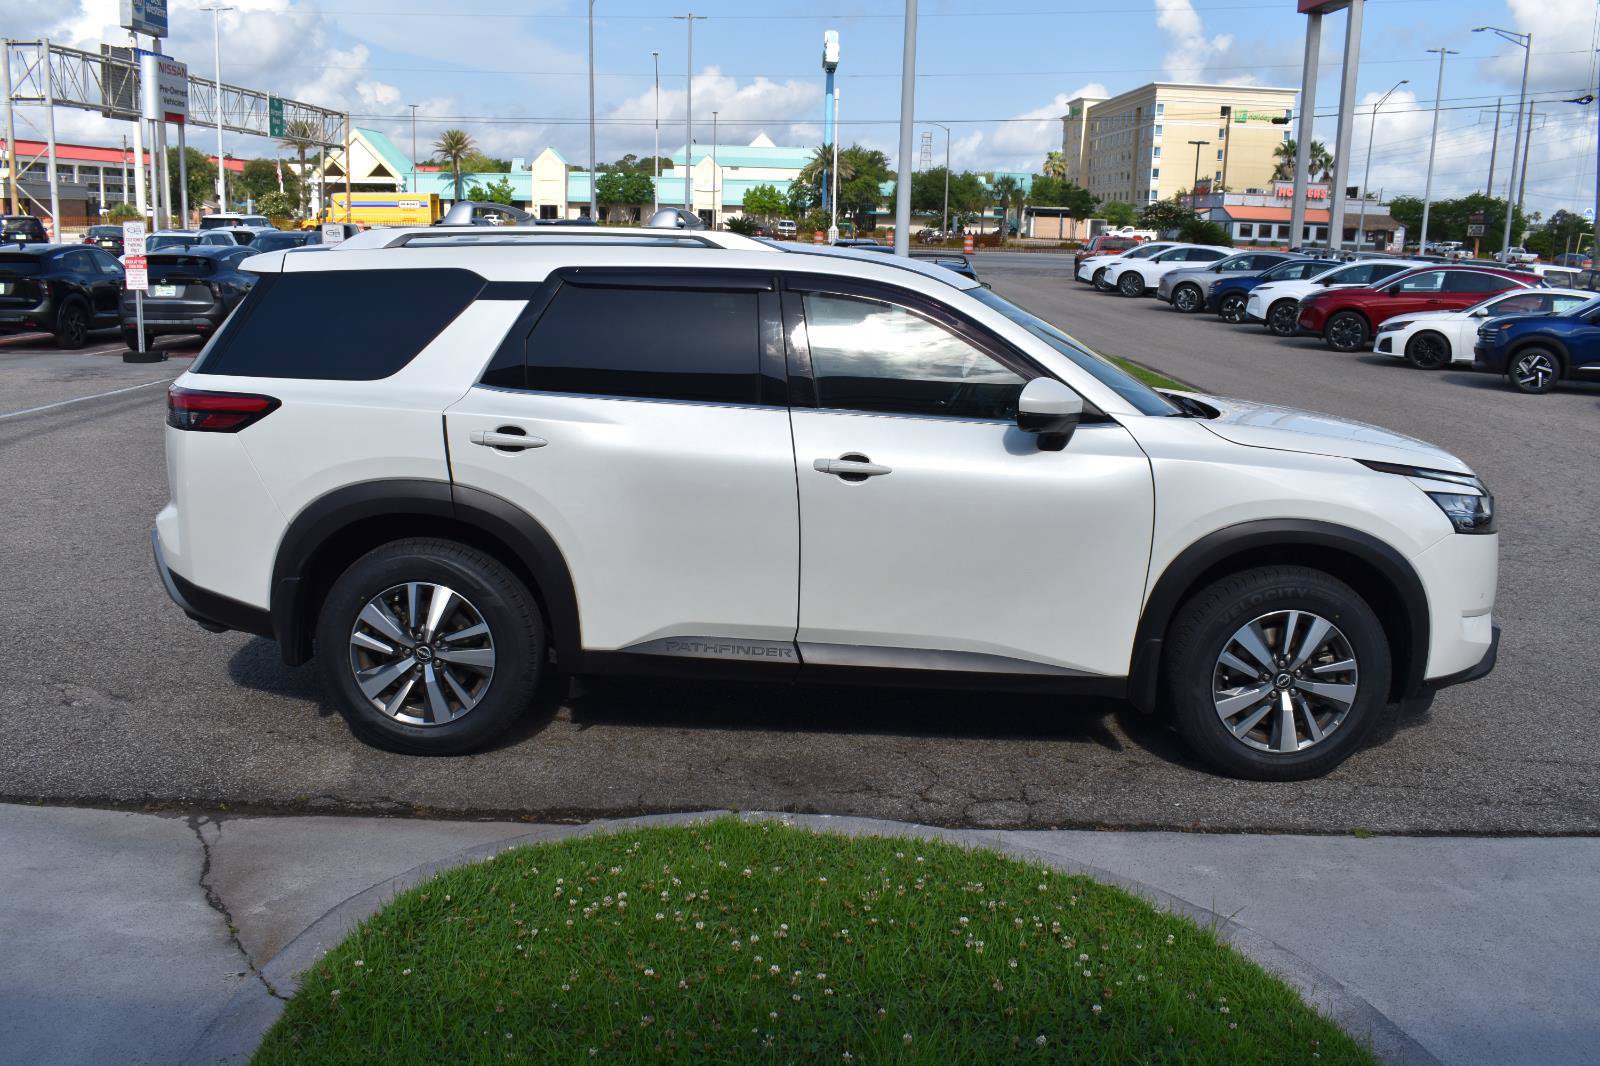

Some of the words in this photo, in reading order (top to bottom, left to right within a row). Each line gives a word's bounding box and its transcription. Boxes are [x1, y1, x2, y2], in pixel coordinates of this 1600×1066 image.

[146, 2, 167, 18] Western
[158, 62, 187, 78] NISSAN
[159, 85, 188, 97] Pre-Owned
[163, 98, 185, 108] Vehicles
[1278, 187, 1328, 199] HOERS
[1218, 587, 1309, 625] VELOCITY
[664, 641, 794, 658] PATHFINDER
